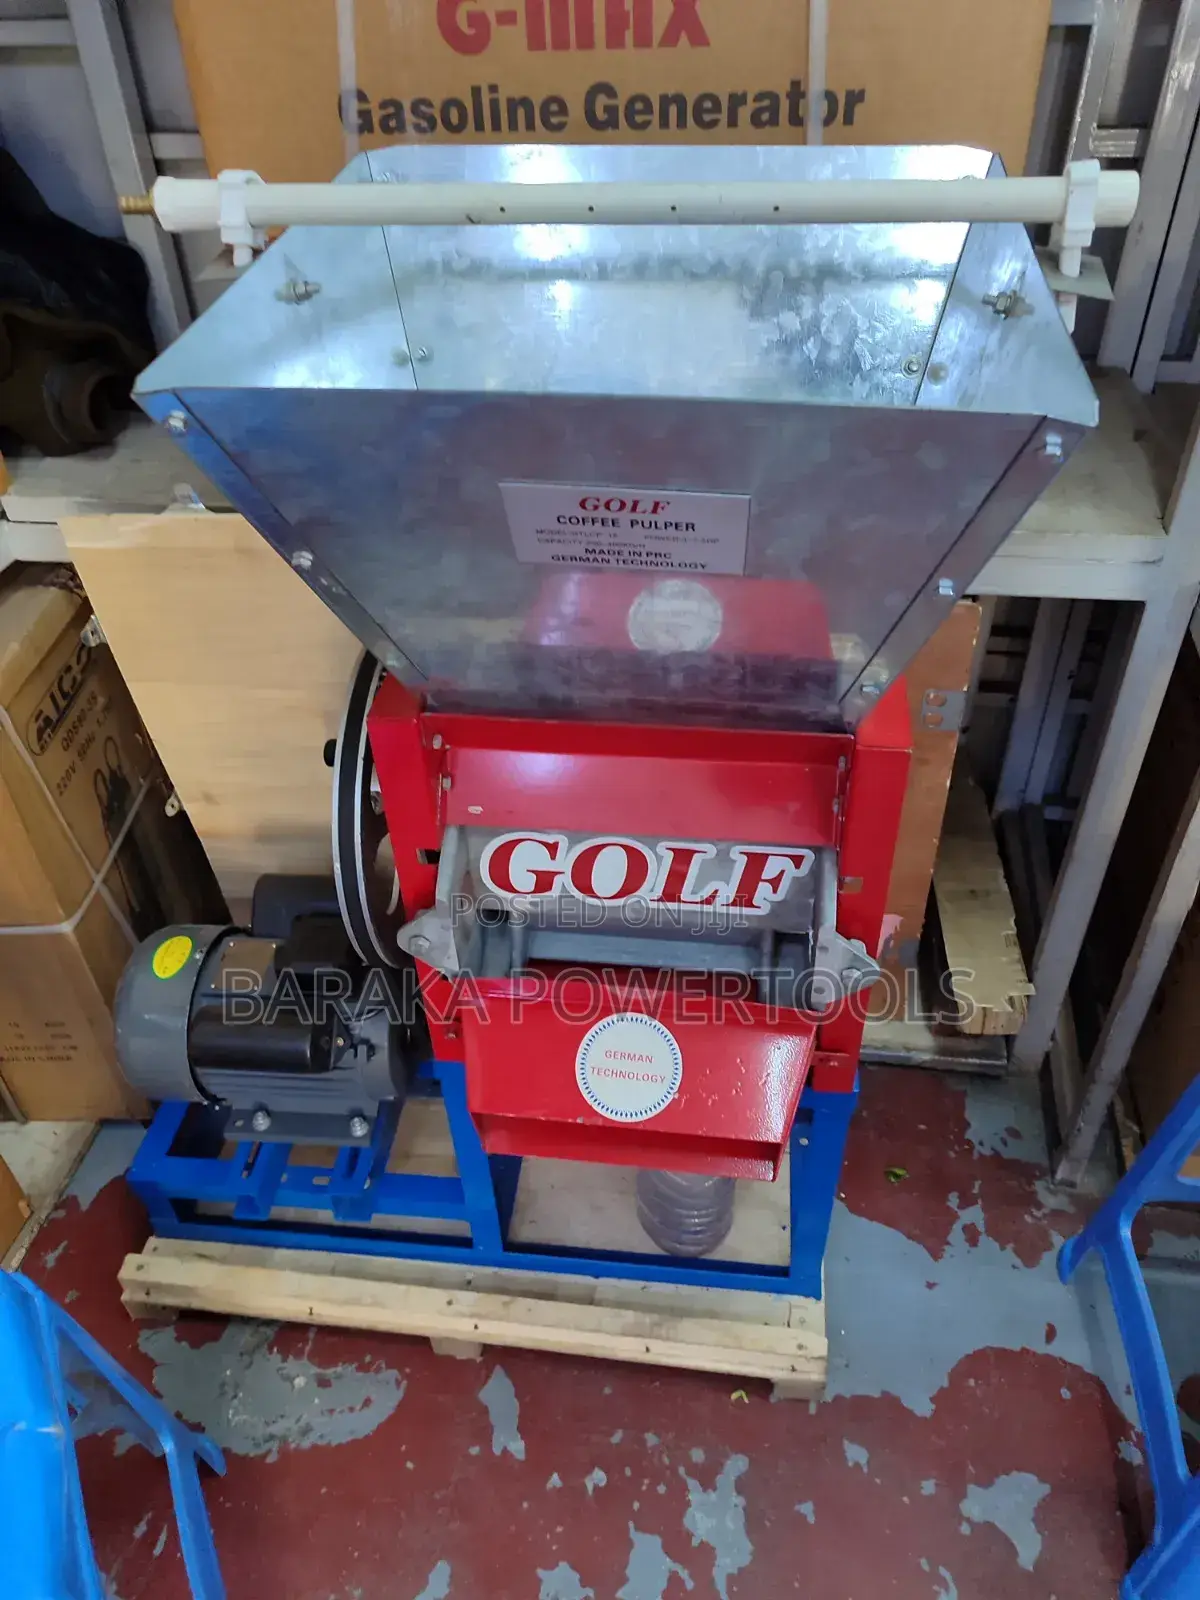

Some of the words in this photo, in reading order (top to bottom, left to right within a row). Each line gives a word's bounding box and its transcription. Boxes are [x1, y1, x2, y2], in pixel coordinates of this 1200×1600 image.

[338, 85, 569, 136] Gasoline
[584, 77, 867, 134] Generator
[578, 496, 671, 516] GOLF
[556, 514, 621, 528] COFFEE
[630, 518, 696, 532] PULPER
[551, 554, 610, 565] GERMAN
[615, 557, 708, 571] TECHNOLOGY
[584, 547, 624, 558] MADE
[628, 550, 643, 558] IN
[645, 550, 672, 560] PRC
[485, 835, 808, 911] GOLF
[604, 1049, 654, 1064] GERMAN
[590, 1066, 666, 1084] TECHNOLOGY
